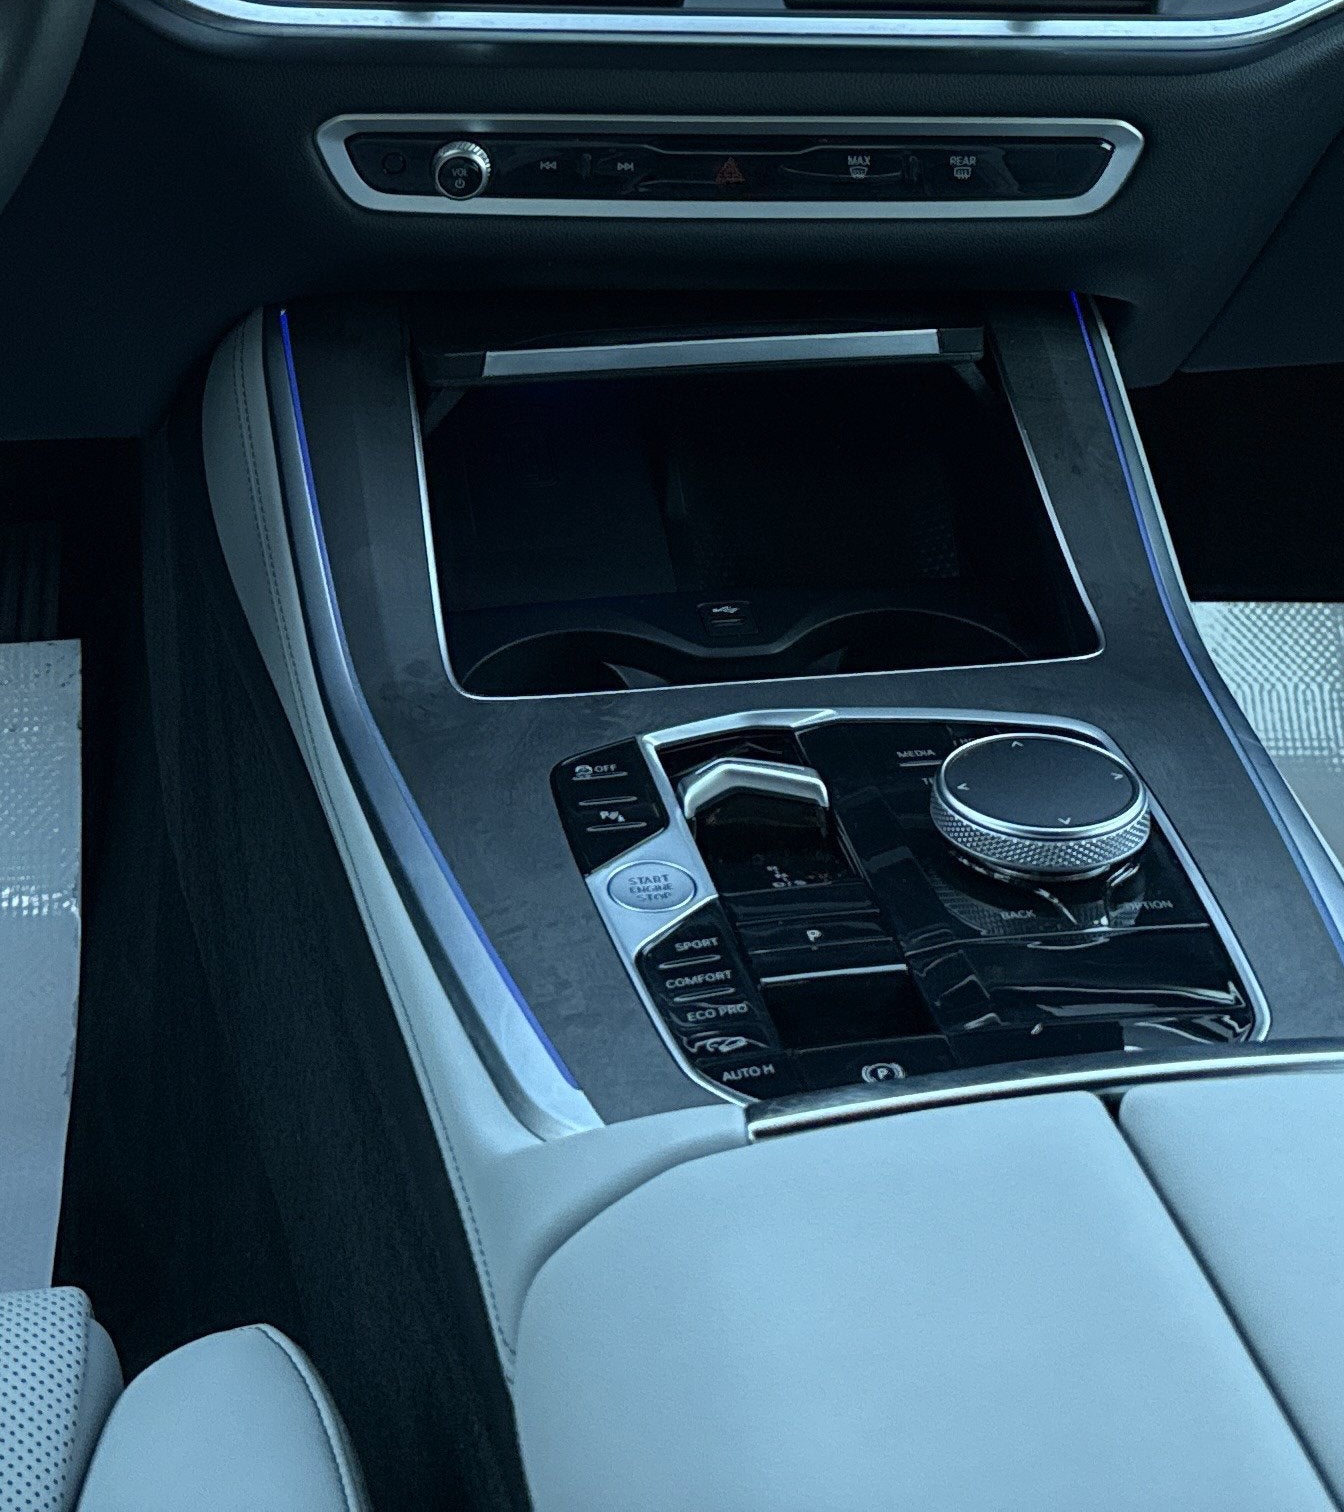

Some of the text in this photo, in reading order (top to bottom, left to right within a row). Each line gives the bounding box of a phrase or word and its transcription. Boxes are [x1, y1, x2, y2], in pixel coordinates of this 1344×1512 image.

[847, 155, 871, 166] MAX
[949, 155, 976, 166] REAR
[896, 749, 936, 758] MEDIA
[594, 763, 617, 773] OFF
[628, 874, 669, 885] START
[636, 891, 672, 901] STOP
[1000, 909, 1037, 920] BACK
[674, 937, 718, 951] SPORT
[665, 970, 732, 988] COMFORT
[687, 1003, 748, 1022] ECO PRO
[722, 1063, 775, 1082] AUTO H
